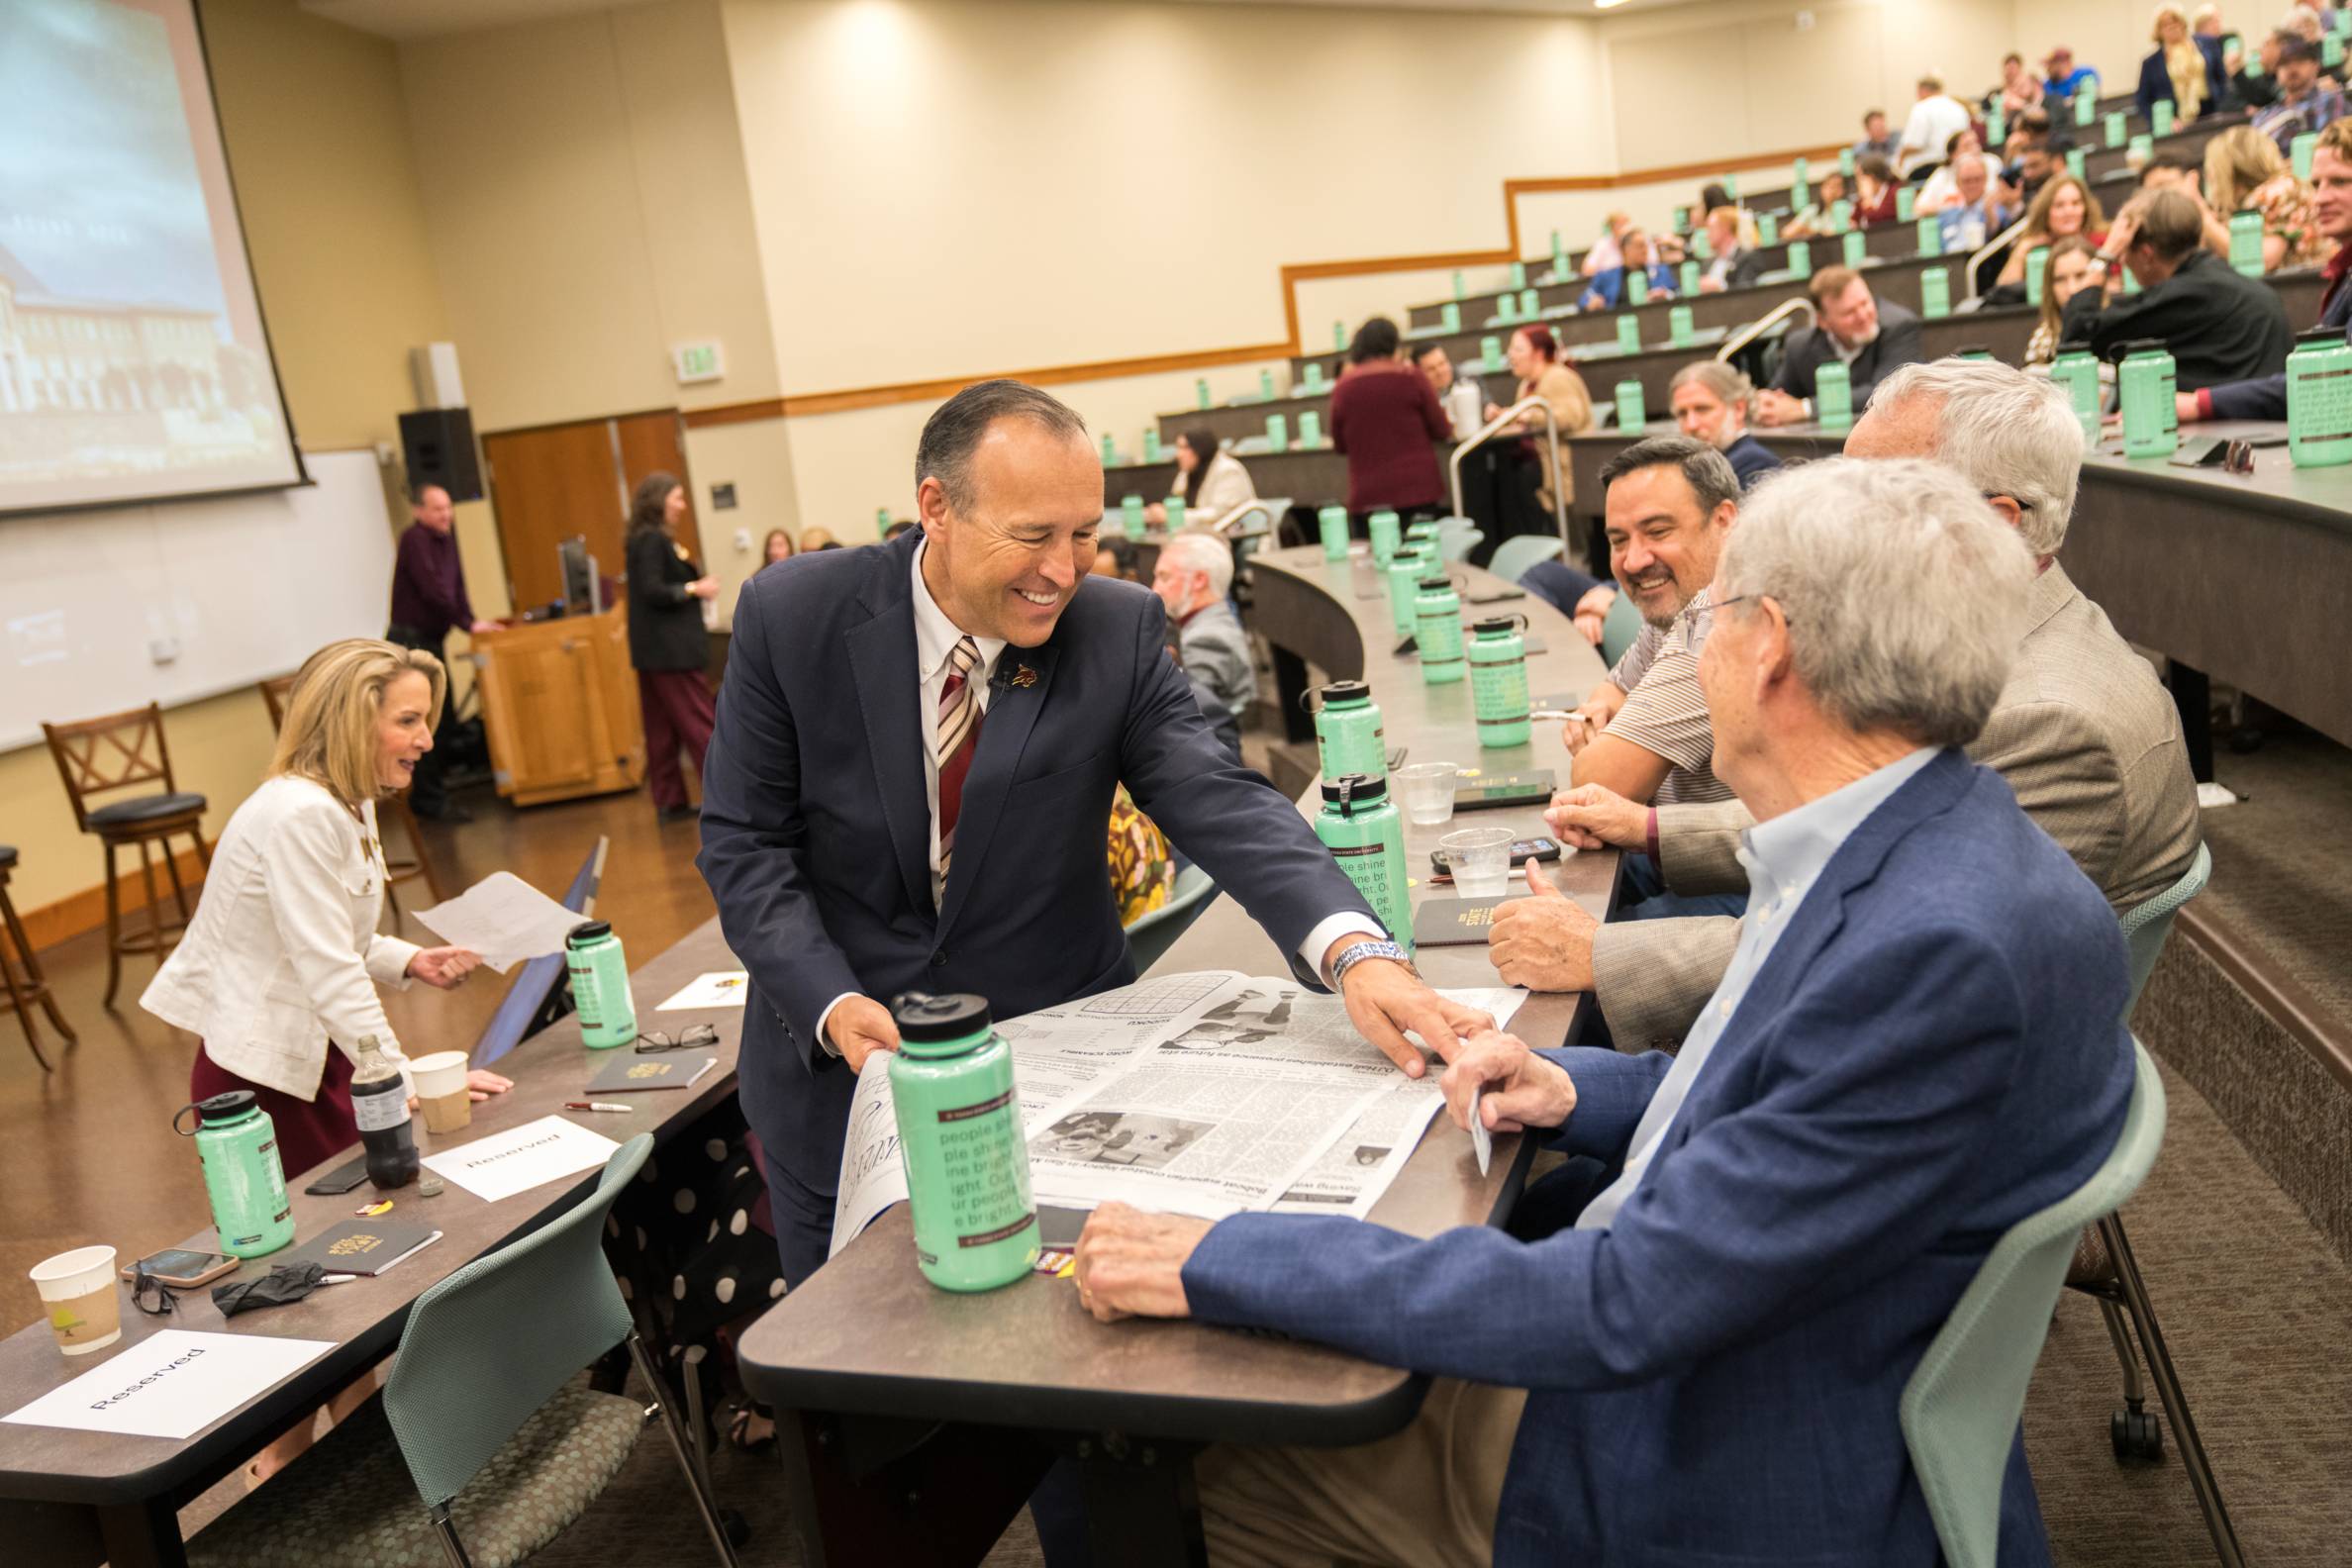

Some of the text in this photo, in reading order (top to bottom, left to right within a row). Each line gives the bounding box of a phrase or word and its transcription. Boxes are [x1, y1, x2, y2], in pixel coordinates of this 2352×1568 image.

[1357, 859, 1386, 871] shine
[1377, 897, 1389, 907] pe
[1378, 906, 1393, 917] shi
[1286, 1058, 1352, 1068] establishes
[939, 1126, 992, 1146] people
[467, 1133, 561, 1169] Reserved
[944, 1146, 968, 1164] ple
[946, 1164, 970, 1179] ine
[1082, 1162, 1119, 1172] legacy
[1121, 1167, 1165, 1177] creates
[1166, 1174, 1221, 1184] superfan
[1224, 1182, 1267, 1195] Bobcat
[951, 1184, 1018, 1212] ur people
[953, 1216, 964, 1227] e
[89, 1347, 207, 1411] Reserved
